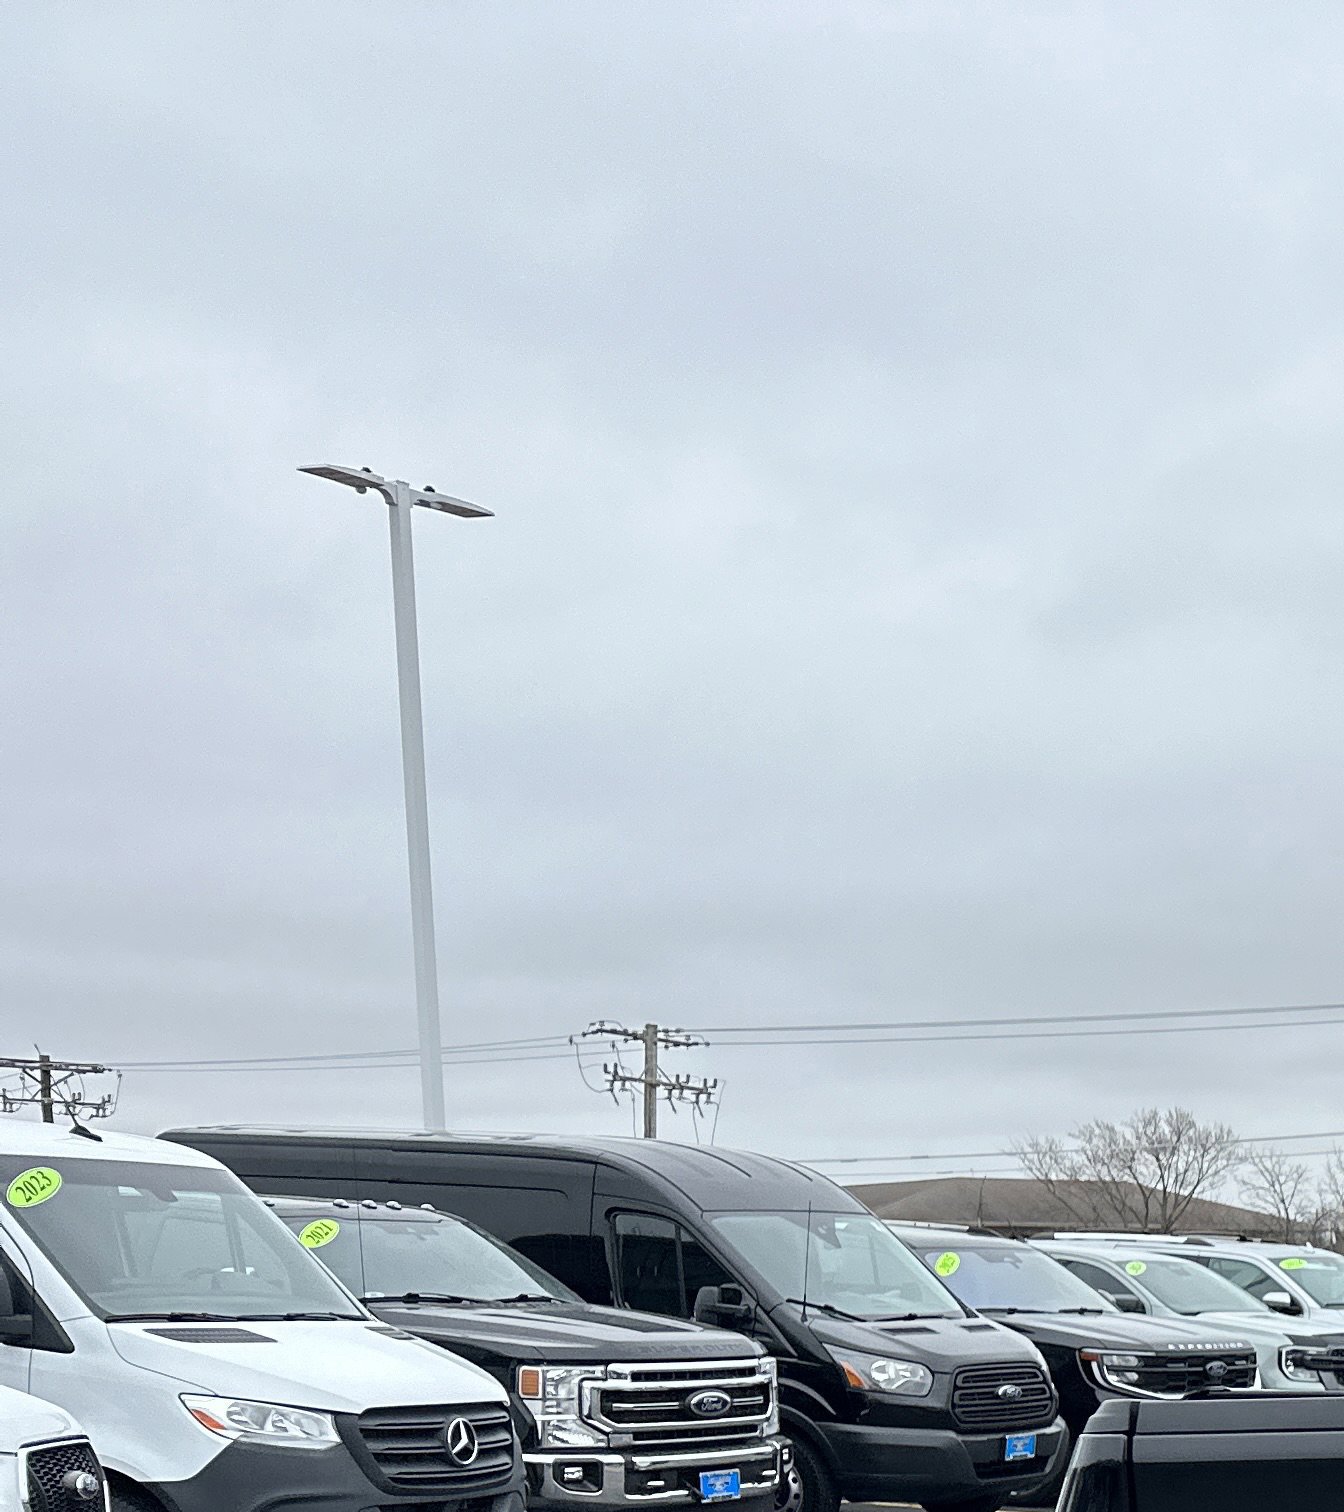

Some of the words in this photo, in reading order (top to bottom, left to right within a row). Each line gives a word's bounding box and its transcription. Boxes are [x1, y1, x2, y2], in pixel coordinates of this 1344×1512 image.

[15, 1171, 52, 1203] 2023
[305, 1222, 333, 1244] 2021
[701, 1397, 723, 1411] Ford
